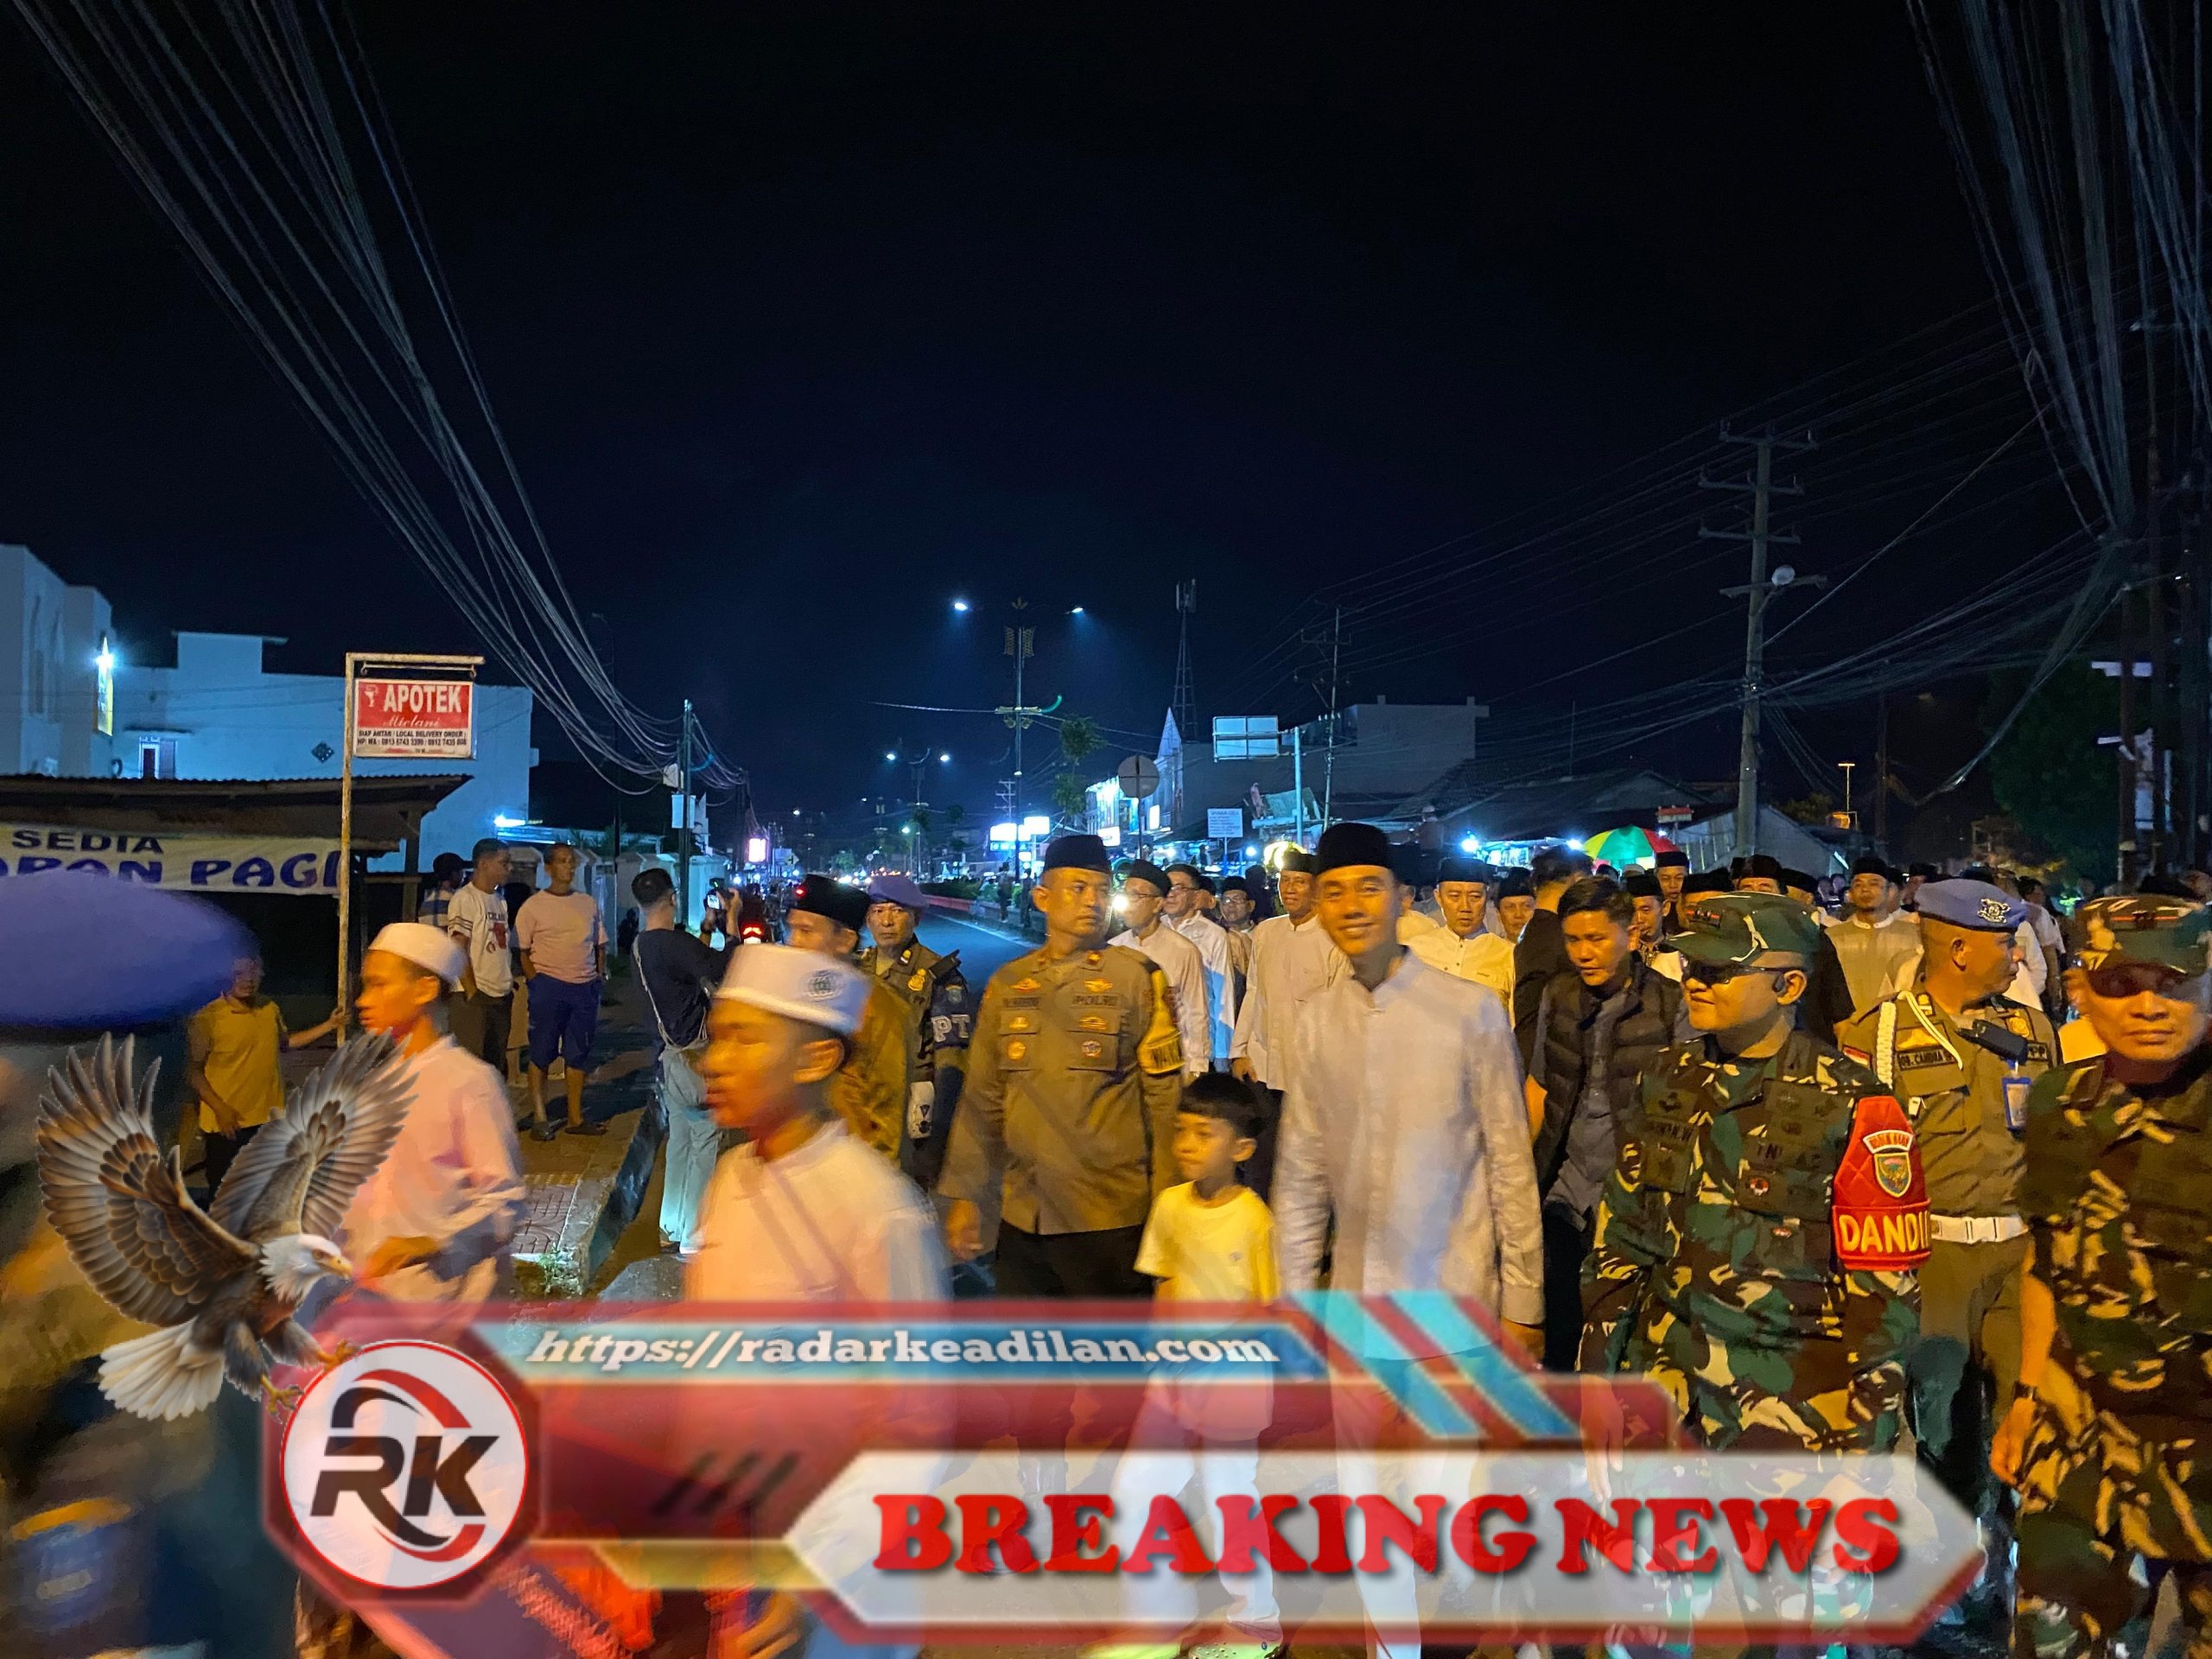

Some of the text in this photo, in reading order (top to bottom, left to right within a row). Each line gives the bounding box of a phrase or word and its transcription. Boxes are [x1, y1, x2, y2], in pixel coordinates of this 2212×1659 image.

[383, 684, 462, 714] APOTEK
[11, 830, 164, 855] SEDIA
[190, 850, 341, 888] PAGI
